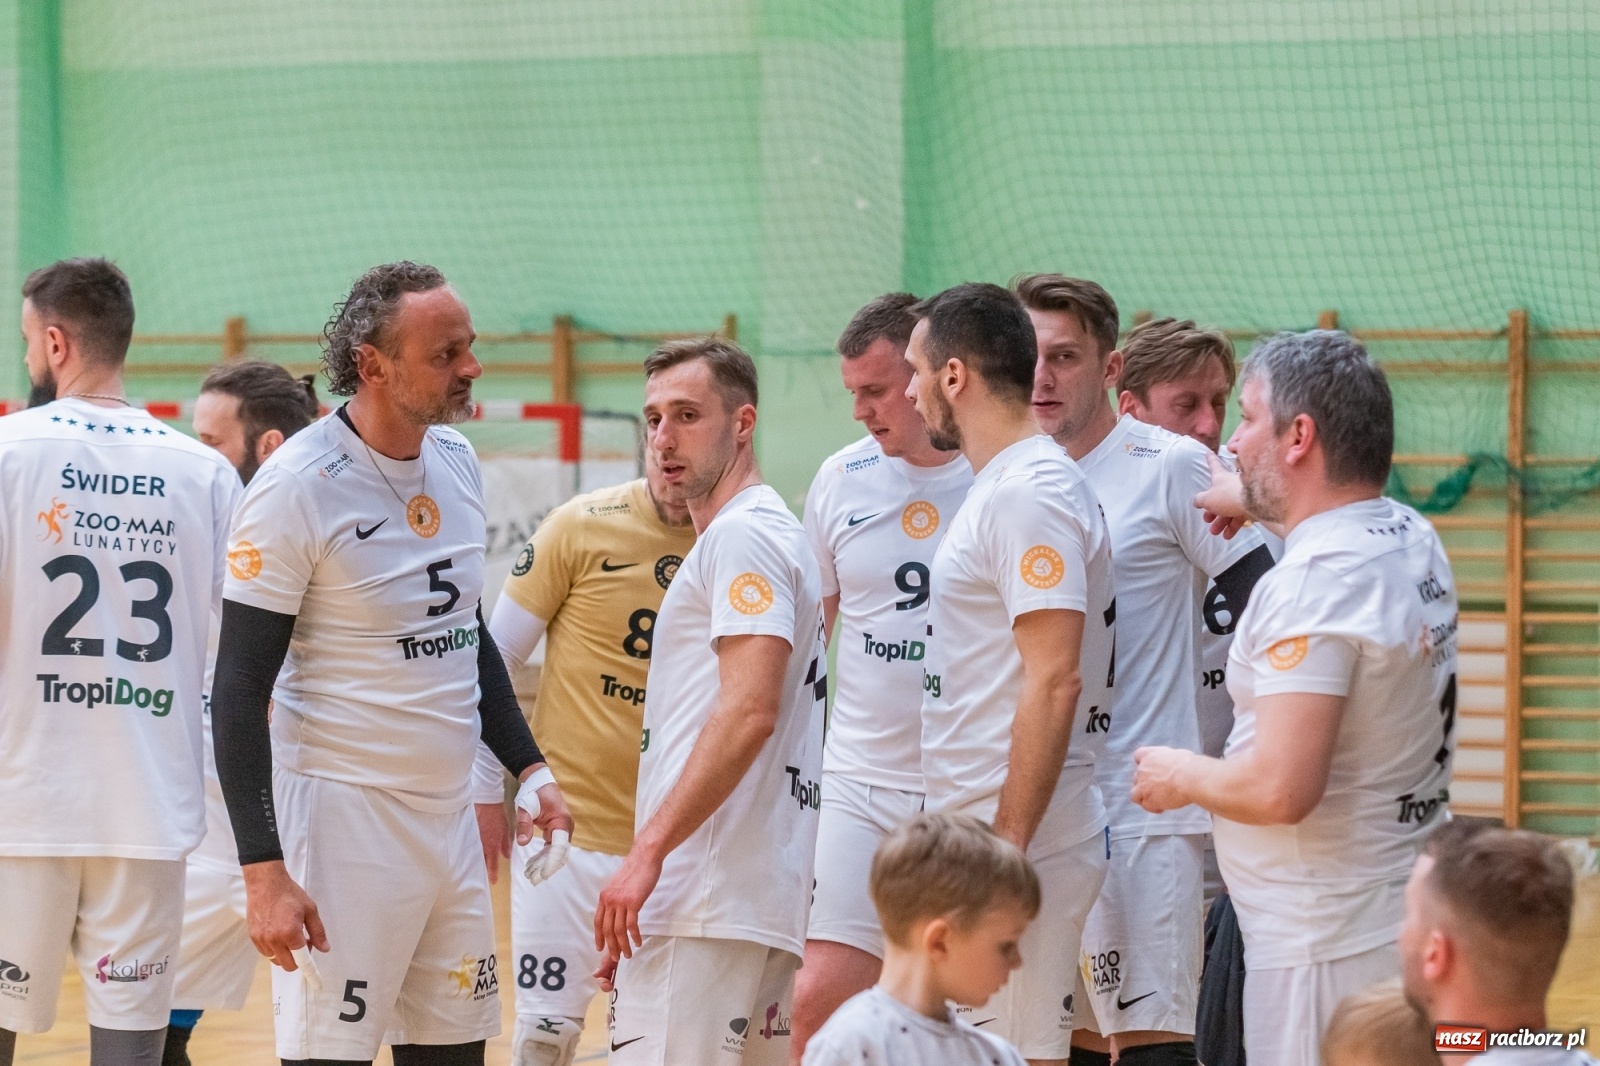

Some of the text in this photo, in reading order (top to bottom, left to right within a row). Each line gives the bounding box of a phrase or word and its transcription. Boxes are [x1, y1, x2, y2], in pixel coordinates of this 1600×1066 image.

[61, 462, 166, 498] ŚWIDER
[73, 531, 177, 556] LUNATYCY
[426, 557, 461, 617] 5
[894, 561, 931, 611] 9
[41, 554, 174, 662] 23
[862, 632, 926, 663] TropiD
[36, 674, 174, 717] TropiDog
[600, 674, 646, 706] Trop
[111, 955, 169, 981] kolgraf
[477, 953, 498, 977] ZO
[517, 953, 567, 991] 88
[1091, 950, 1120, 972] ZOO
[474, 971, 498, 994] MA
[338, 979, 368, 1023] 5
